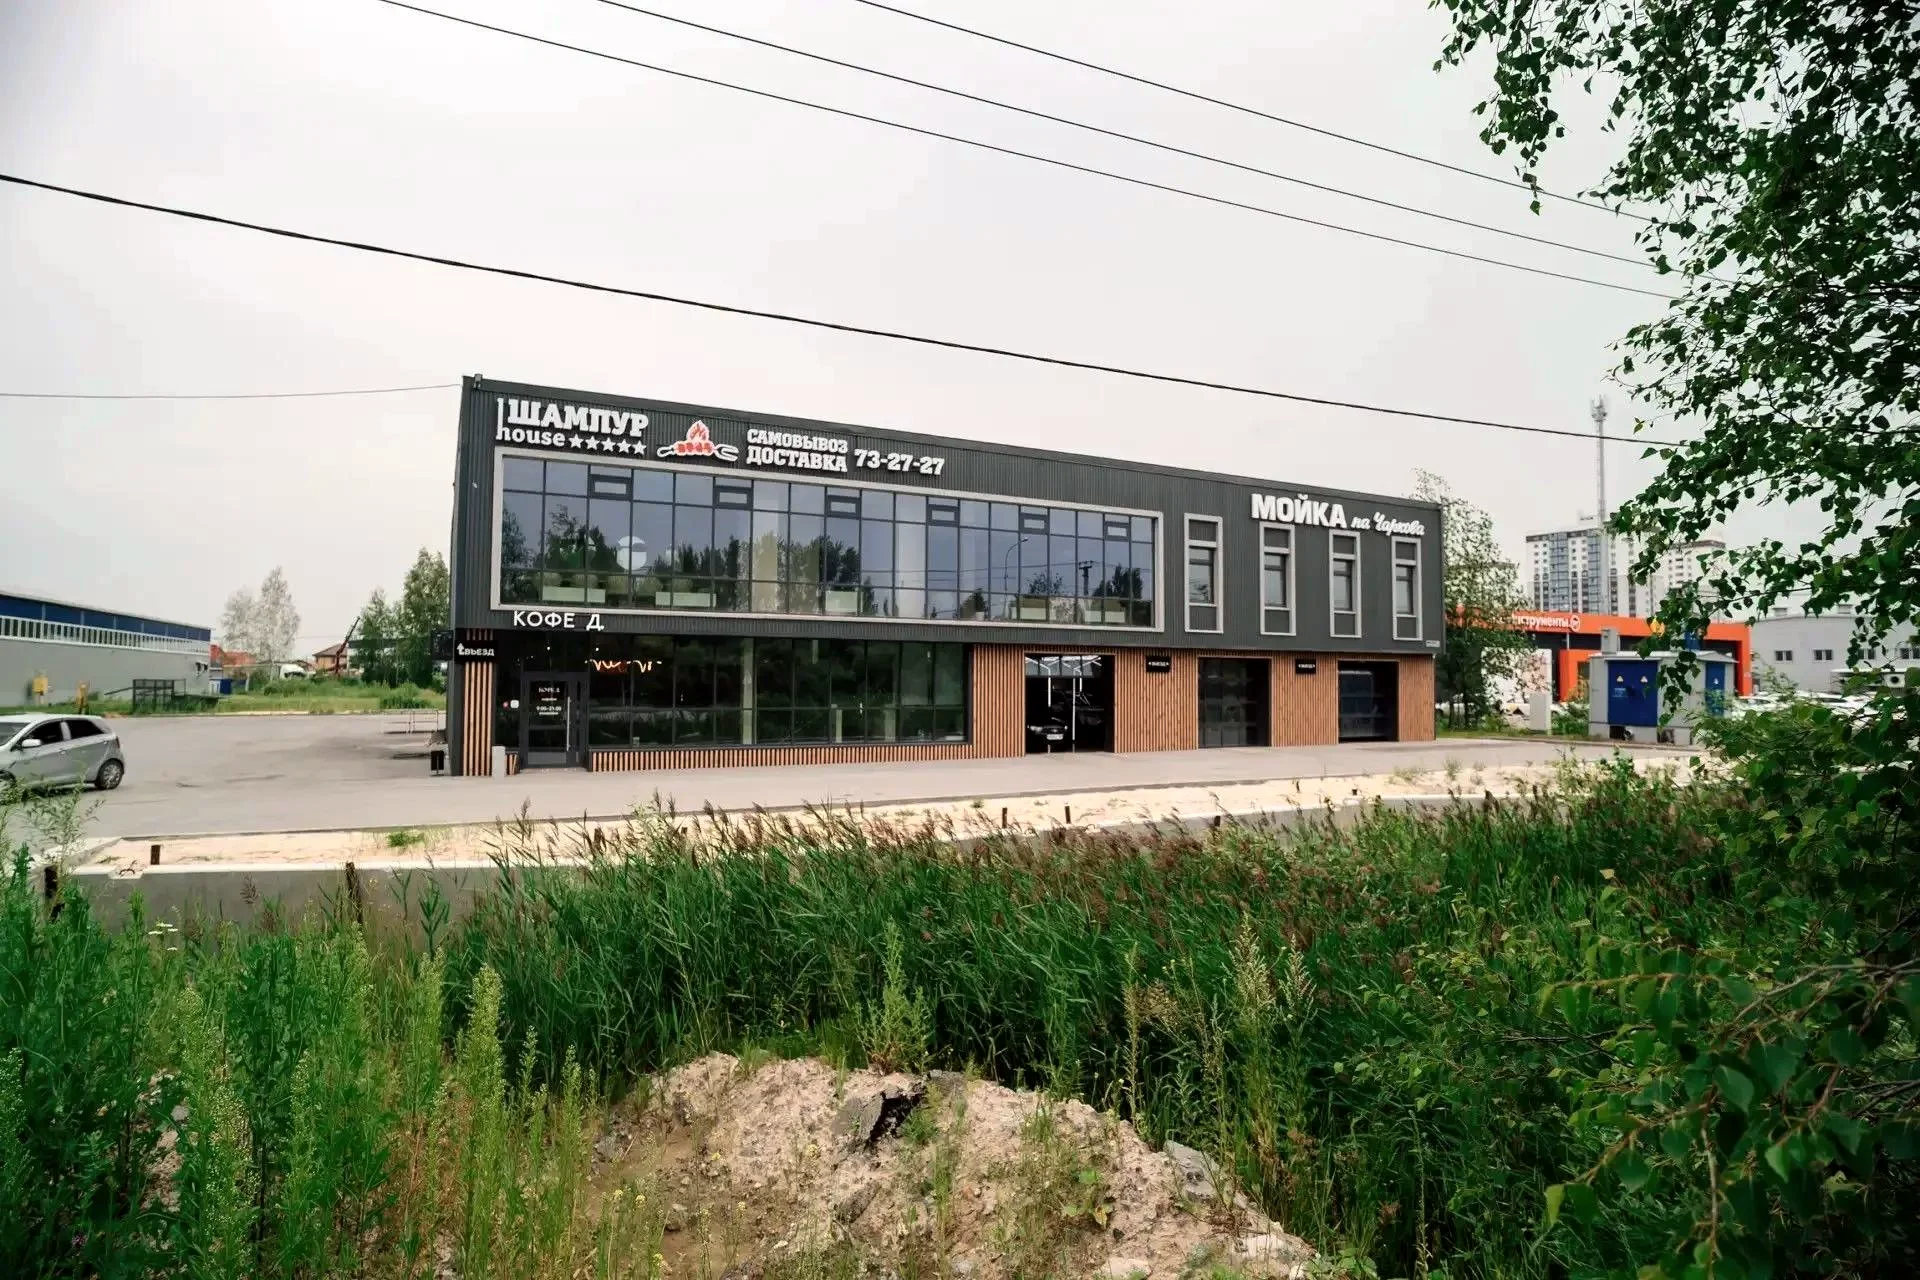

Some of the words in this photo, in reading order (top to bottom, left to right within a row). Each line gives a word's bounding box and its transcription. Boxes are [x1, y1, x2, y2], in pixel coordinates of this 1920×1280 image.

[507, 398, 649, 437] ШАМПУР
[747, 428, 848, 454] САМОВЫВОЗ
[746, 445, 848, 473] ДОСТАВКА
[854, 448, 945, 475] 73-27-27
[1251, 493, 1348, 529] МОЙКА
[1350, 515, 1371, 530] на
[513, 610, 575, 629] КОФЕ
